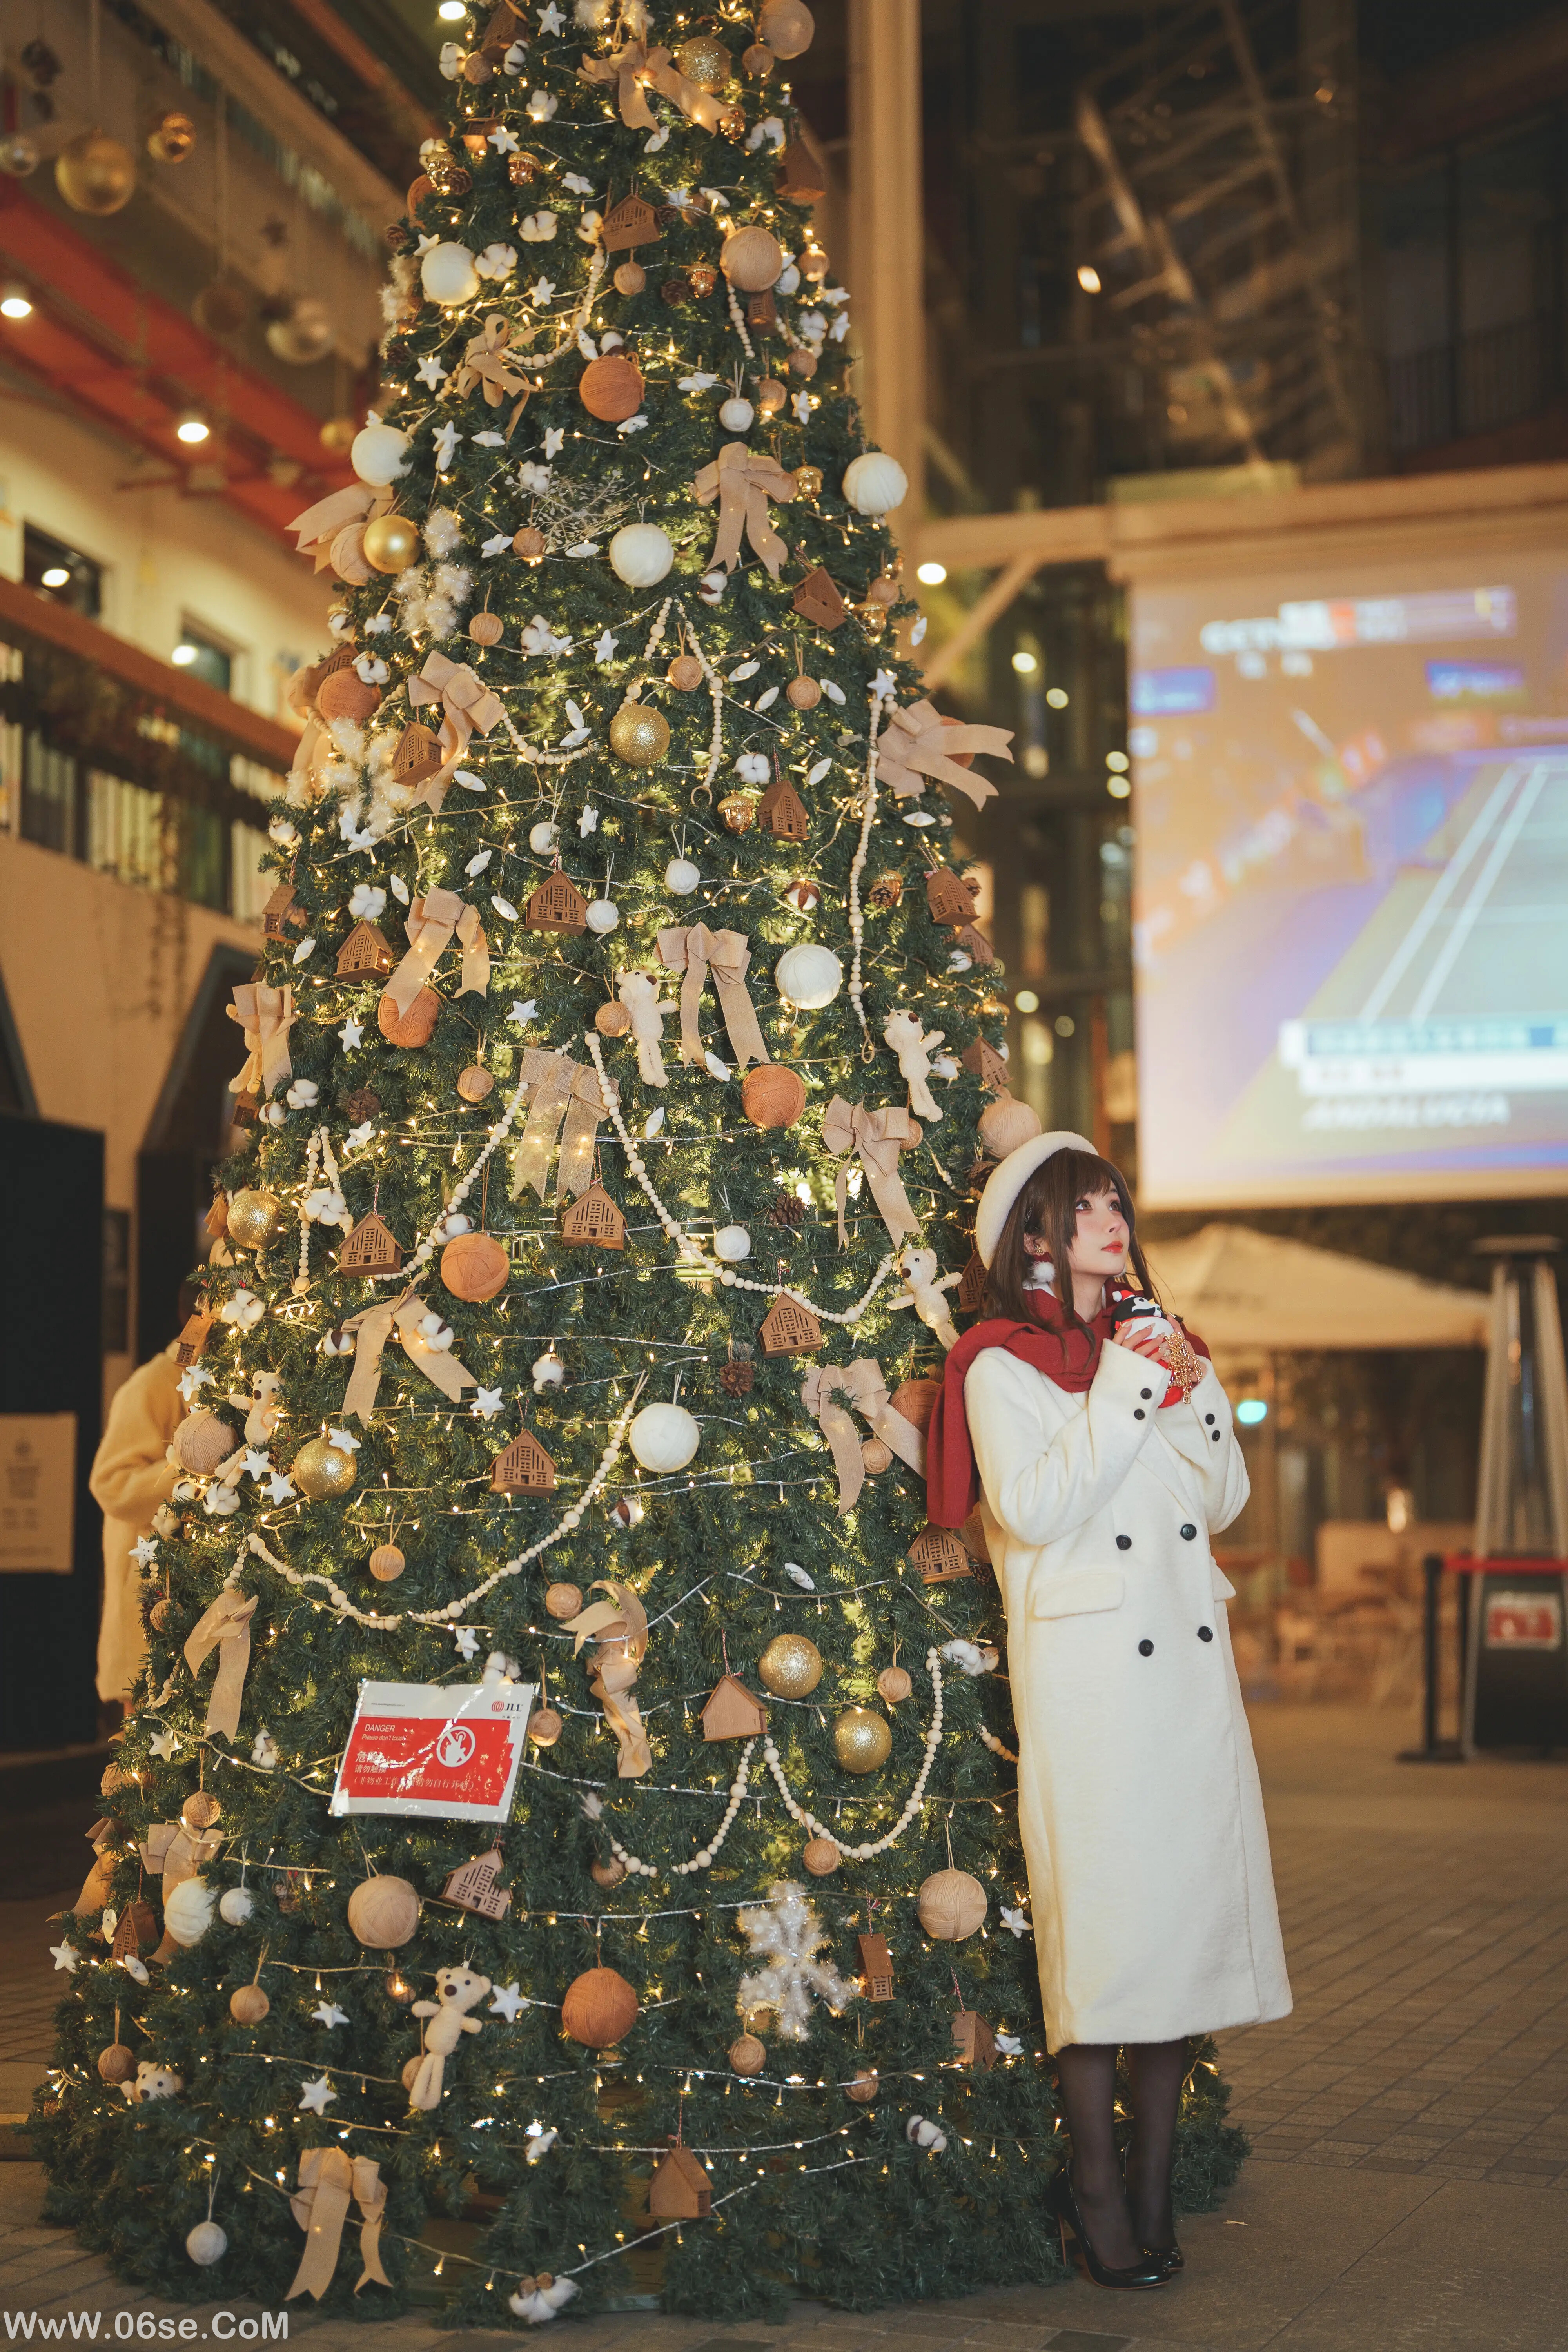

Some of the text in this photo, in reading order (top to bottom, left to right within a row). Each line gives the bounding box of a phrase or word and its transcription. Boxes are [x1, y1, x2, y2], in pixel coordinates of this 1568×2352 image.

[504, 1703, 522, 1712] JLL
[364, 1724, 396, 1733] DANGER
[354, 1764, 387, 1774] 请勿触摸
